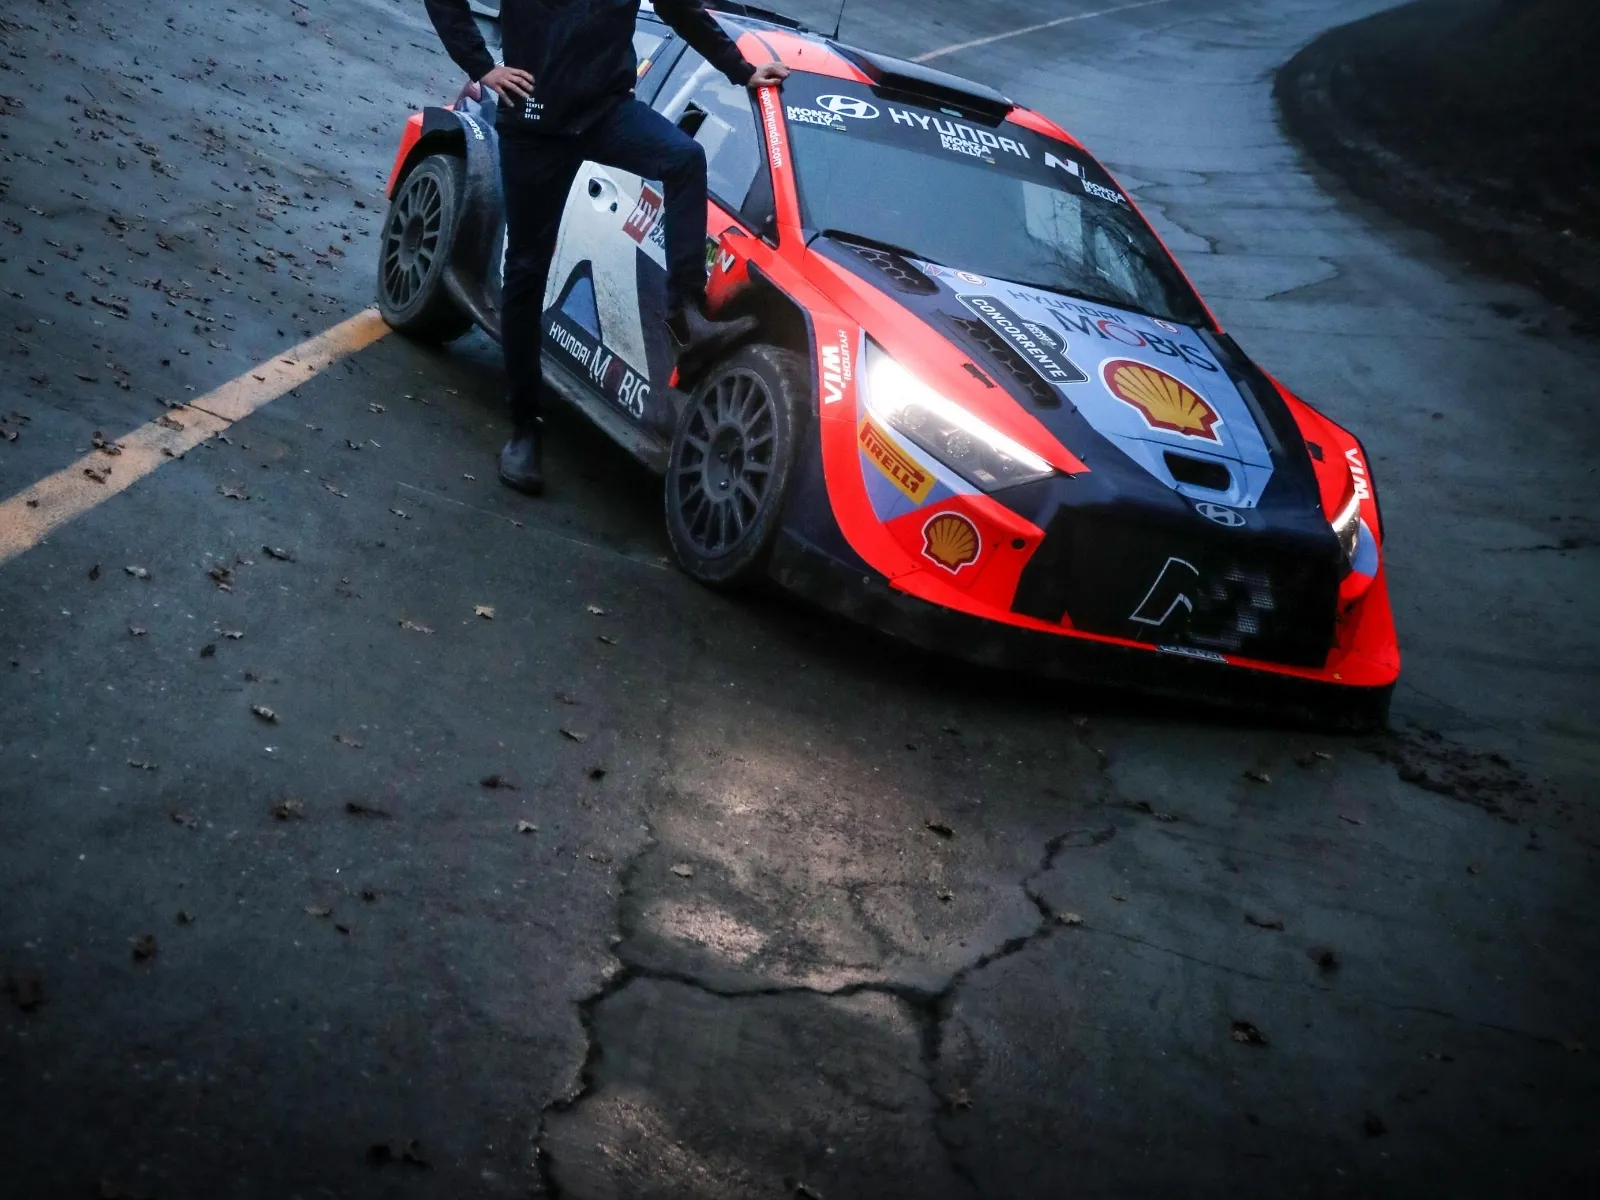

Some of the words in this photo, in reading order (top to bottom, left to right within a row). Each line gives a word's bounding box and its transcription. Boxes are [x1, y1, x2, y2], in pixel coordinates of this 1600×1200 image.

[761, 86, 782, 168] rsport.hyundai.com
[787, 106, 843, 122] MONZA
[787, 112, 832, 127] RALLY
[887, 107, 1031, 159] HYUNDAI
[940, 134, 991, 154] MONZA
[942, 141, 981, 157] RALLY
[1006, 289, 1127, 325] HYUNDAI
[549, 321, 591, 366] HYUNDAI
[838, 328, 852, 381] HYUNDAI
[971, 298, 1067, 379] CONCORRENTE
[1045, 307, 1218, 373] MOBIS
[859, 421, 926, 494] PIRELLI
